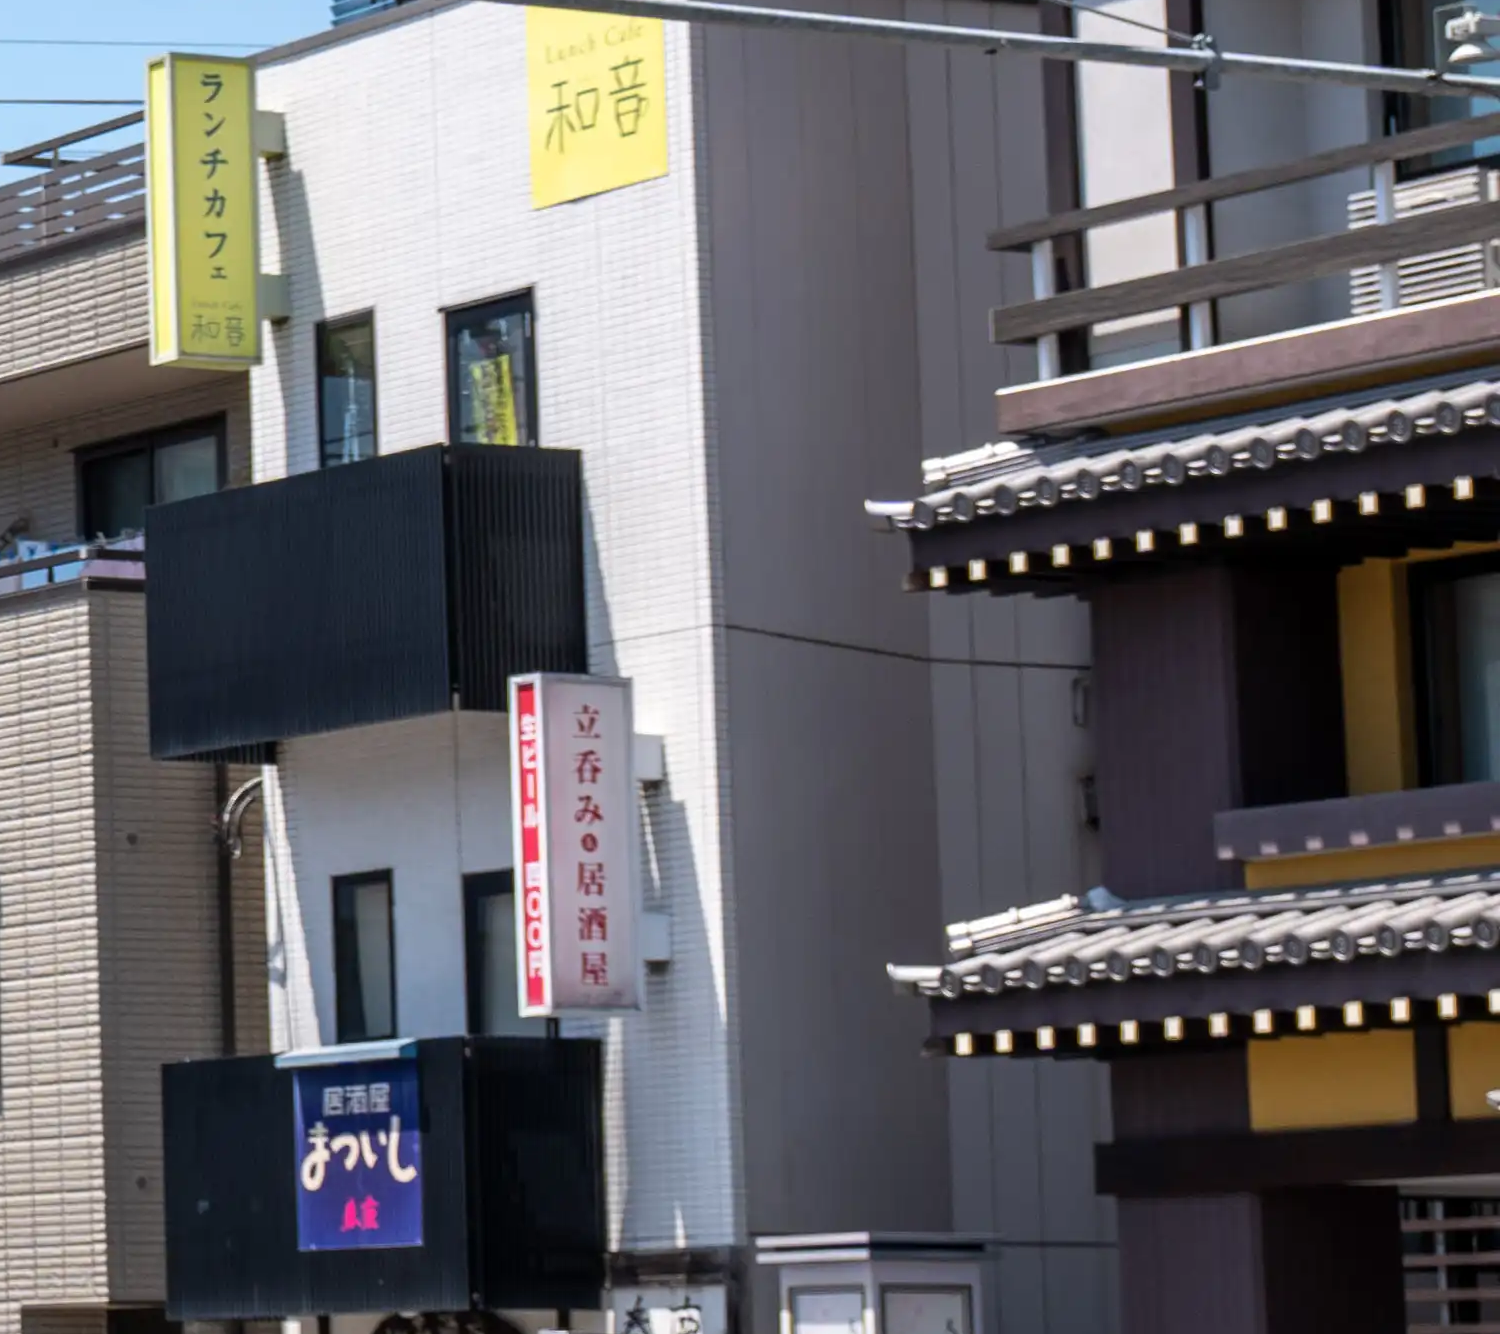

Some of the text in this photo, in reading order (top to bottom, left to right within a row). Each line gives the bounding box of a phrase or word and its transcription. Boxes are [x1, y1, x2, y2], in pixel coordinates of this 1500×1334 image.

[545, 55, 650, 155] 和音
[200, 73, 229, 280] ランチカフェ
[190, 314, 246, 347] 和音
[322, 1082, 391, 1116] 居酒屋
[301, 1115, 418, 1192] まついし
